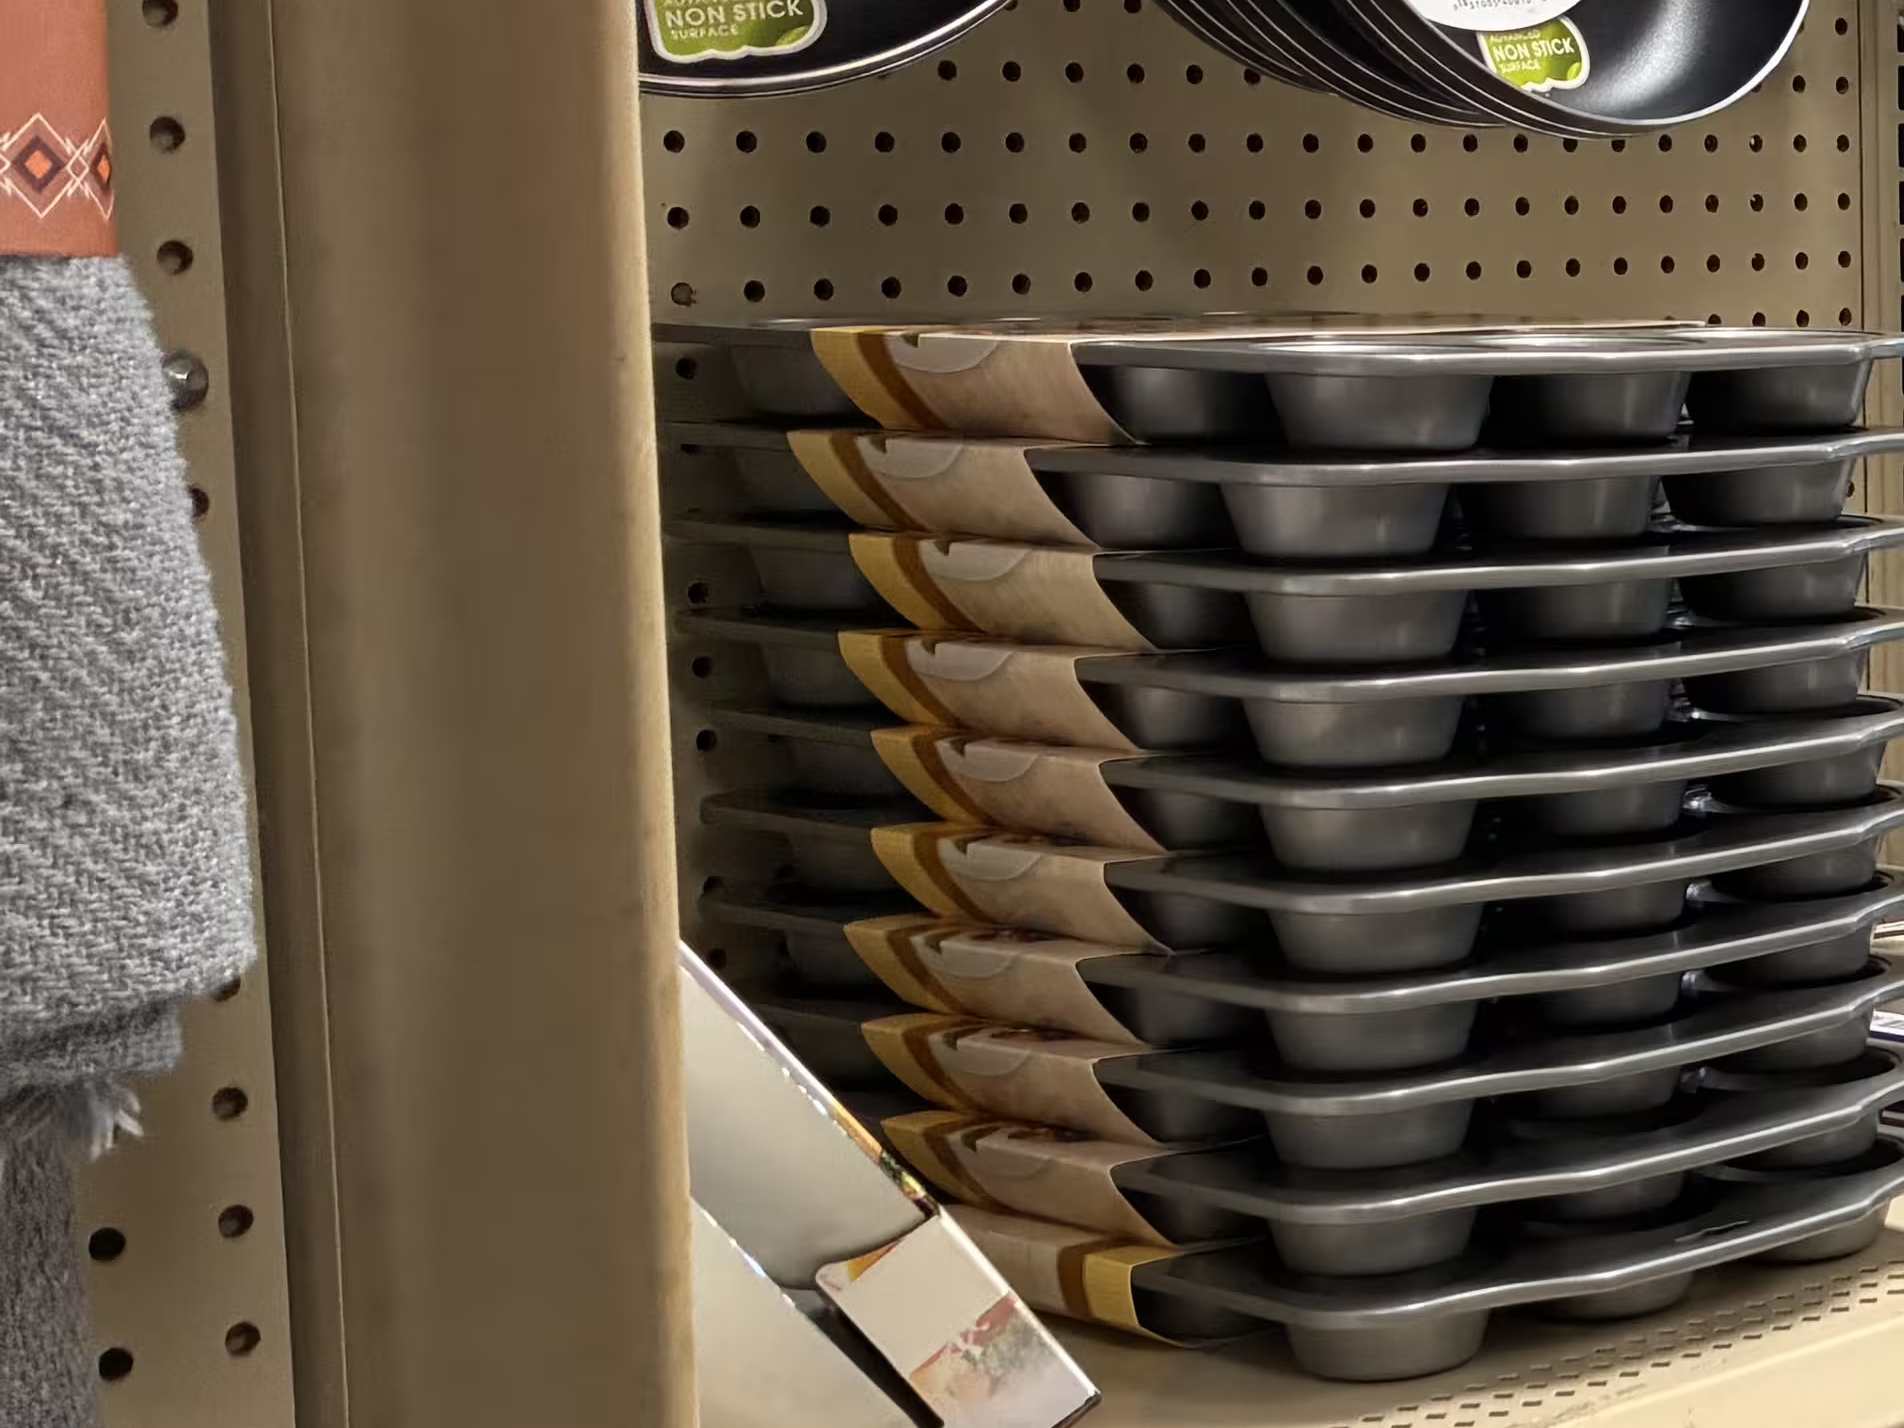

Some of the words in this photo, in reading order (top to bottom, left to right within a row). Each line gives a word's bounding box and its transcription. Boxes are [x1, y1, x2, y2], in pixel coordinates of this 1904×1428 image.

[666, 7, 726, 29] NON
[671, 25, 738, 40] SURFACE
[1492, 44, 1529, 61] NON
[1533, 38, 1575, 56] STICK
